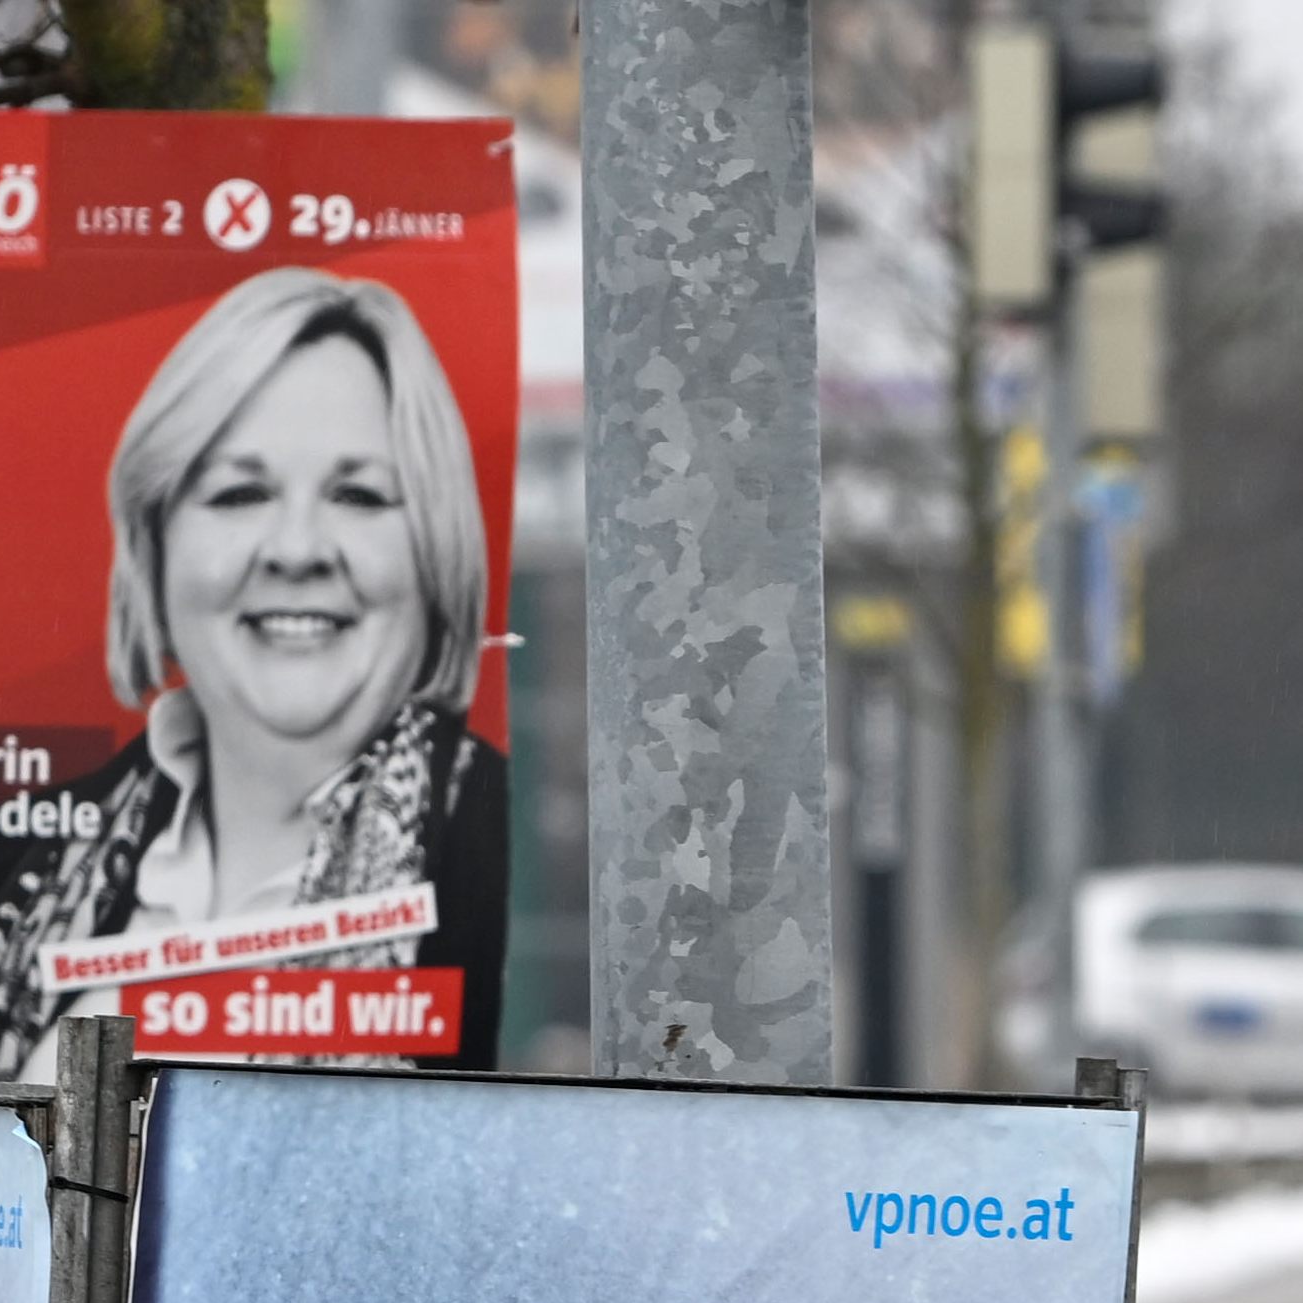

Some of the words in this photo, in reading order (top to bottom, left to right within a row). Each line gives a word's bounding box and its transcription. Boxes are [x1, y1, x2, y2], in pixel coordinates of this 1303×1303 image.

[76, 205, 151, 234] LISTE
[161, 200, 184, 235] 2
[289, 193, 371, 245] 29.
[374, 208, 464, 240] JÄNNER
[52, 945, 151, 983] Besser
[161, 934, 205, 967] für
[216, 918, 327, 958] unseren
[335, 897, 427, 939] Bezirk!
[142, 991, 208, 1035] so
[225, 976, 335, 1036] sind
[348, 975, 446, 1036] wir.
[845, 1187, 1075, 1249] vpnoe.at
